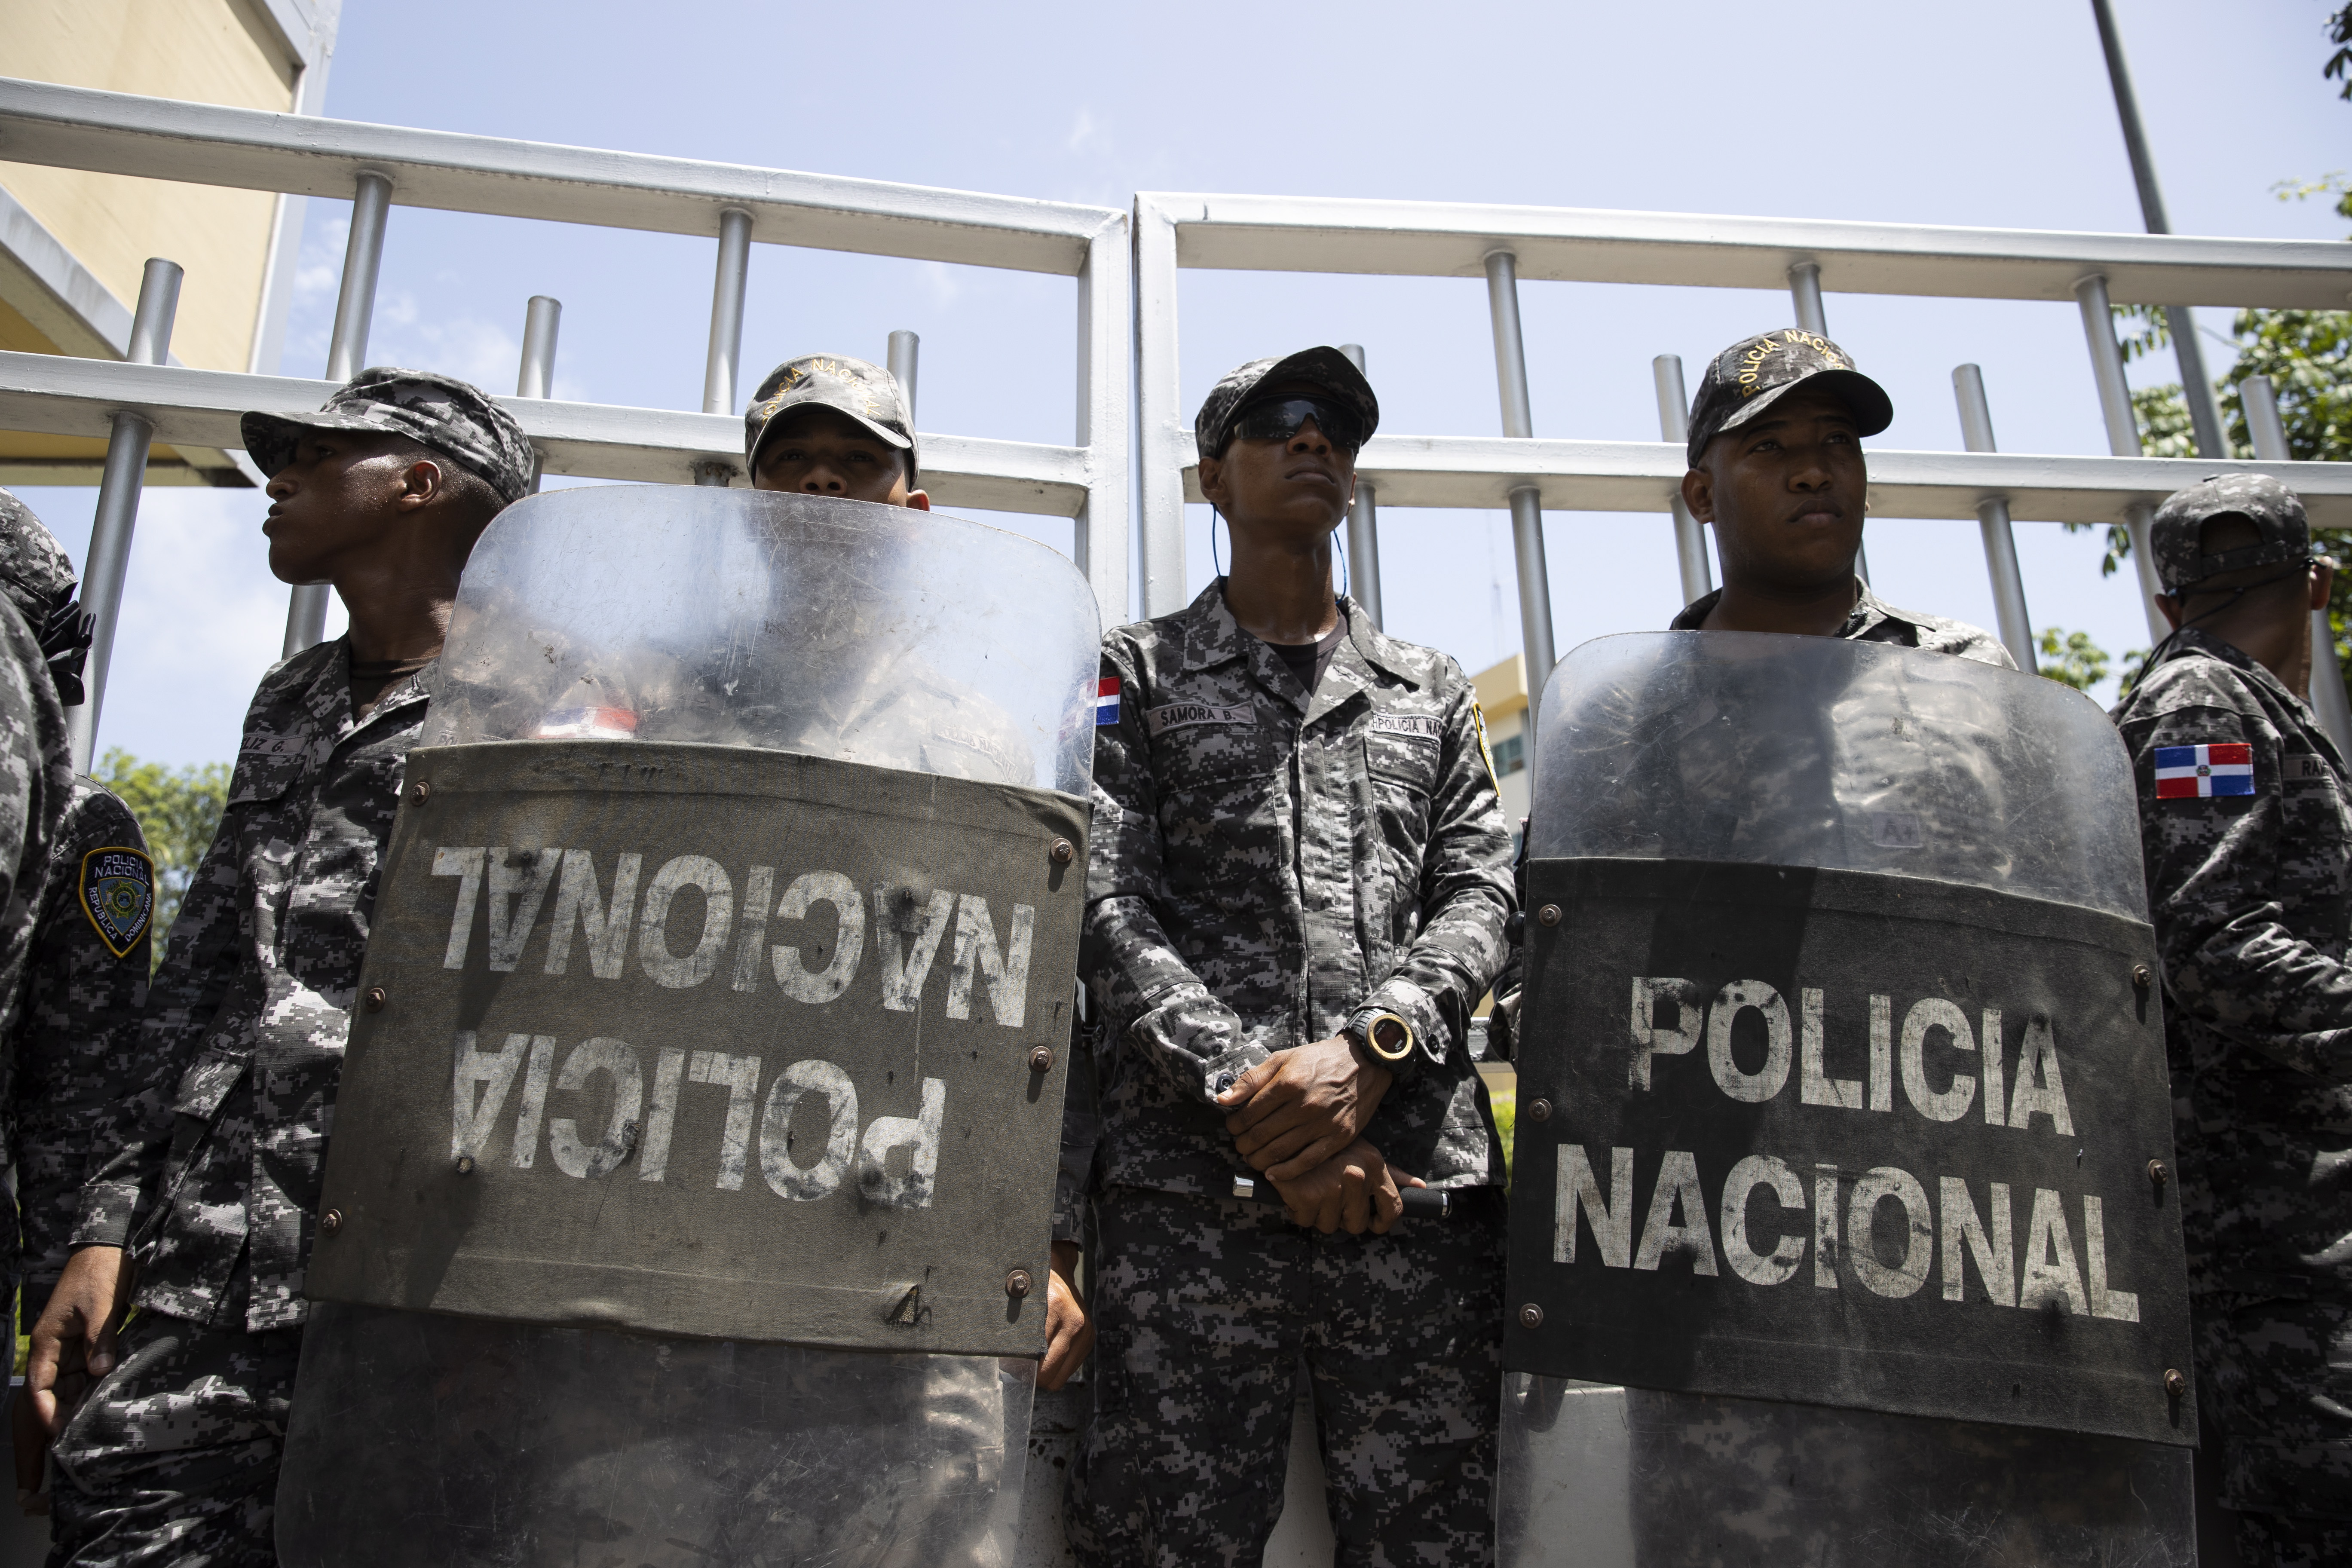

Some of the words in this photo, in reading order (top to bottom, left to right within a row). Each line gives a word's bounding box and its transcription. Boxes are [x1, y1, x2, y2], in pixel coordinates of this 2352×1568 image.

[812, 358, 882, 416] NACIONAL
[1739, 338, 1781, 398] POLICIA
[1161, 706, 1216, 726] SAMORA
[1222, 710, 1236, 720] B.
[1378, 717, 1420, 733] POLICIA
[271, 740, 285, 753] G.
[2302, 760, 2324, 776] RA
[95, 865, 150, 886] NACIONAL
[104, 854, 144, 871] POLICIA
[88, 886, 118, 941] REPUBLICA
[124, 893, 152, 942] DOMINICANA
[430, 846, 1036, 1028] NACIONAL
[1627, 976, 2075, 1138] POLICIA
[451, 1030, 947, 1209] POLICIA
[1553, 1143, 2141, 1323] NACIONAL
